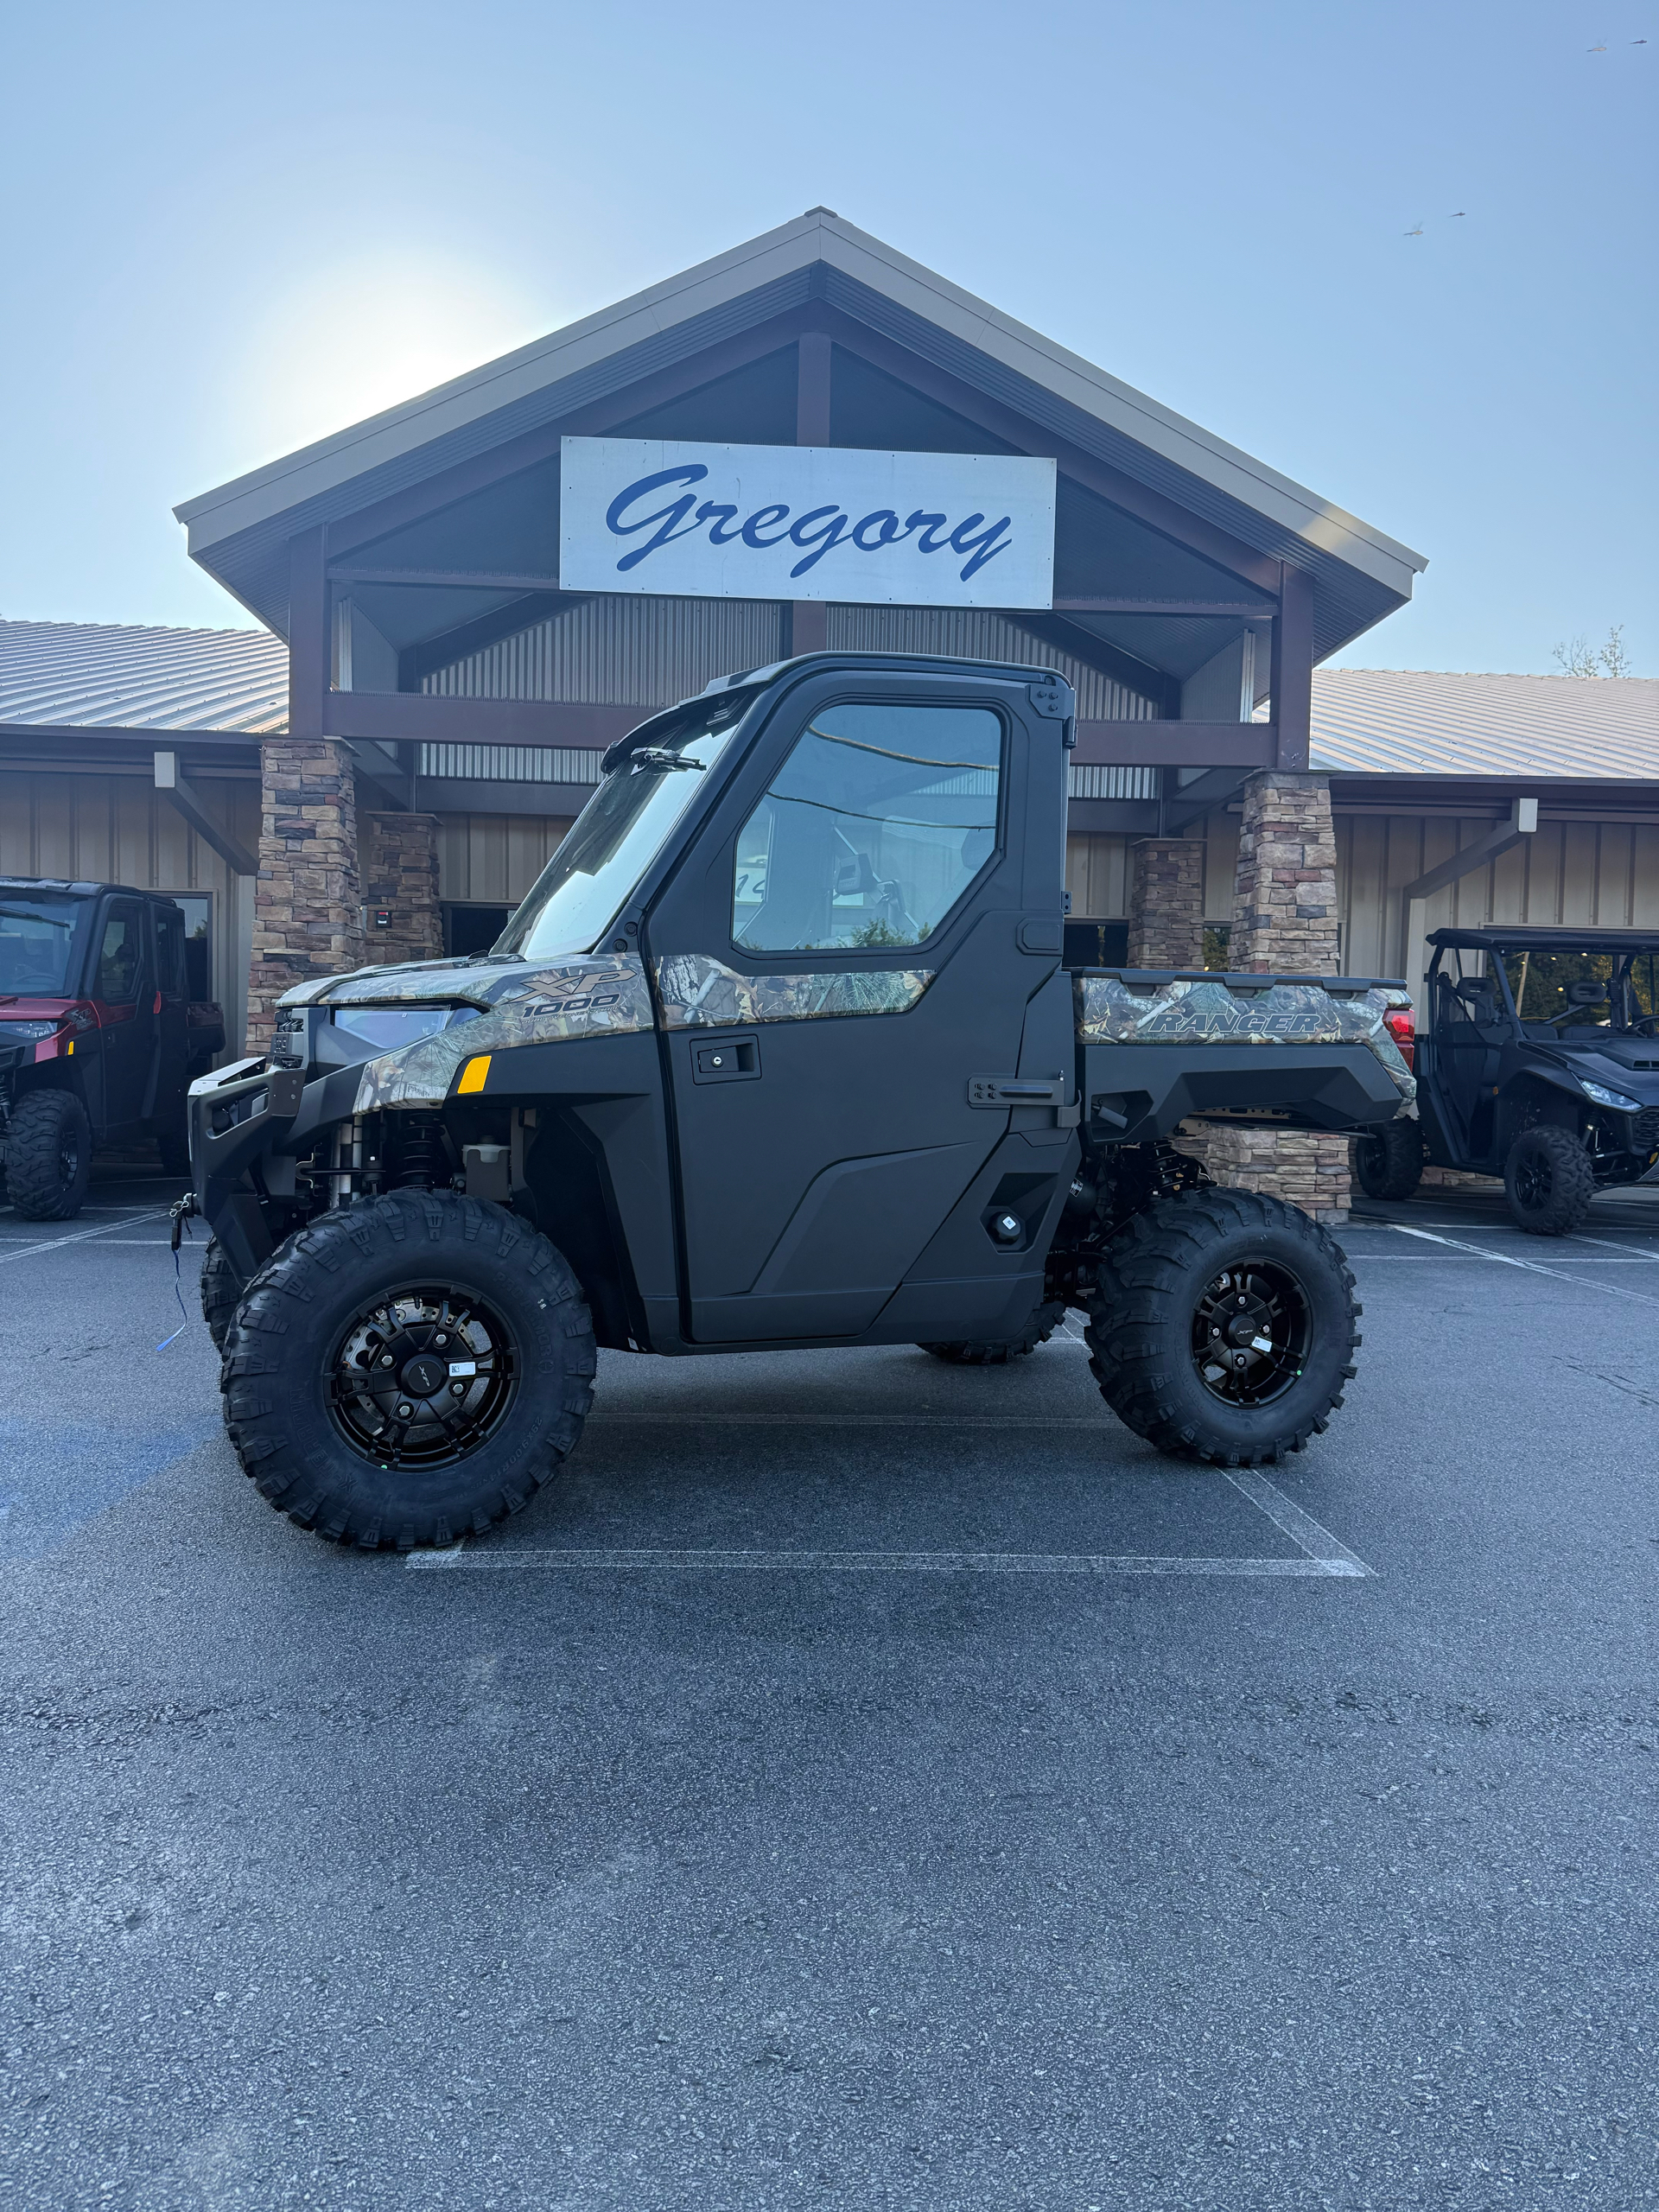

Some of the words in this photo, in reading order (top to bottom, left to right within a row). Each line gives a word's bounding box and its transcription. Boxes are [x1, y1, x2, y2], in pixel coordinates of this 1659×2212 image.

[606, 463, 1012, 582] Gregory
[501, 969, 638, 1005] XP
[522, 994, 620, 1018] 1000
[1148, 1014, 1321, 1033] RANGER
